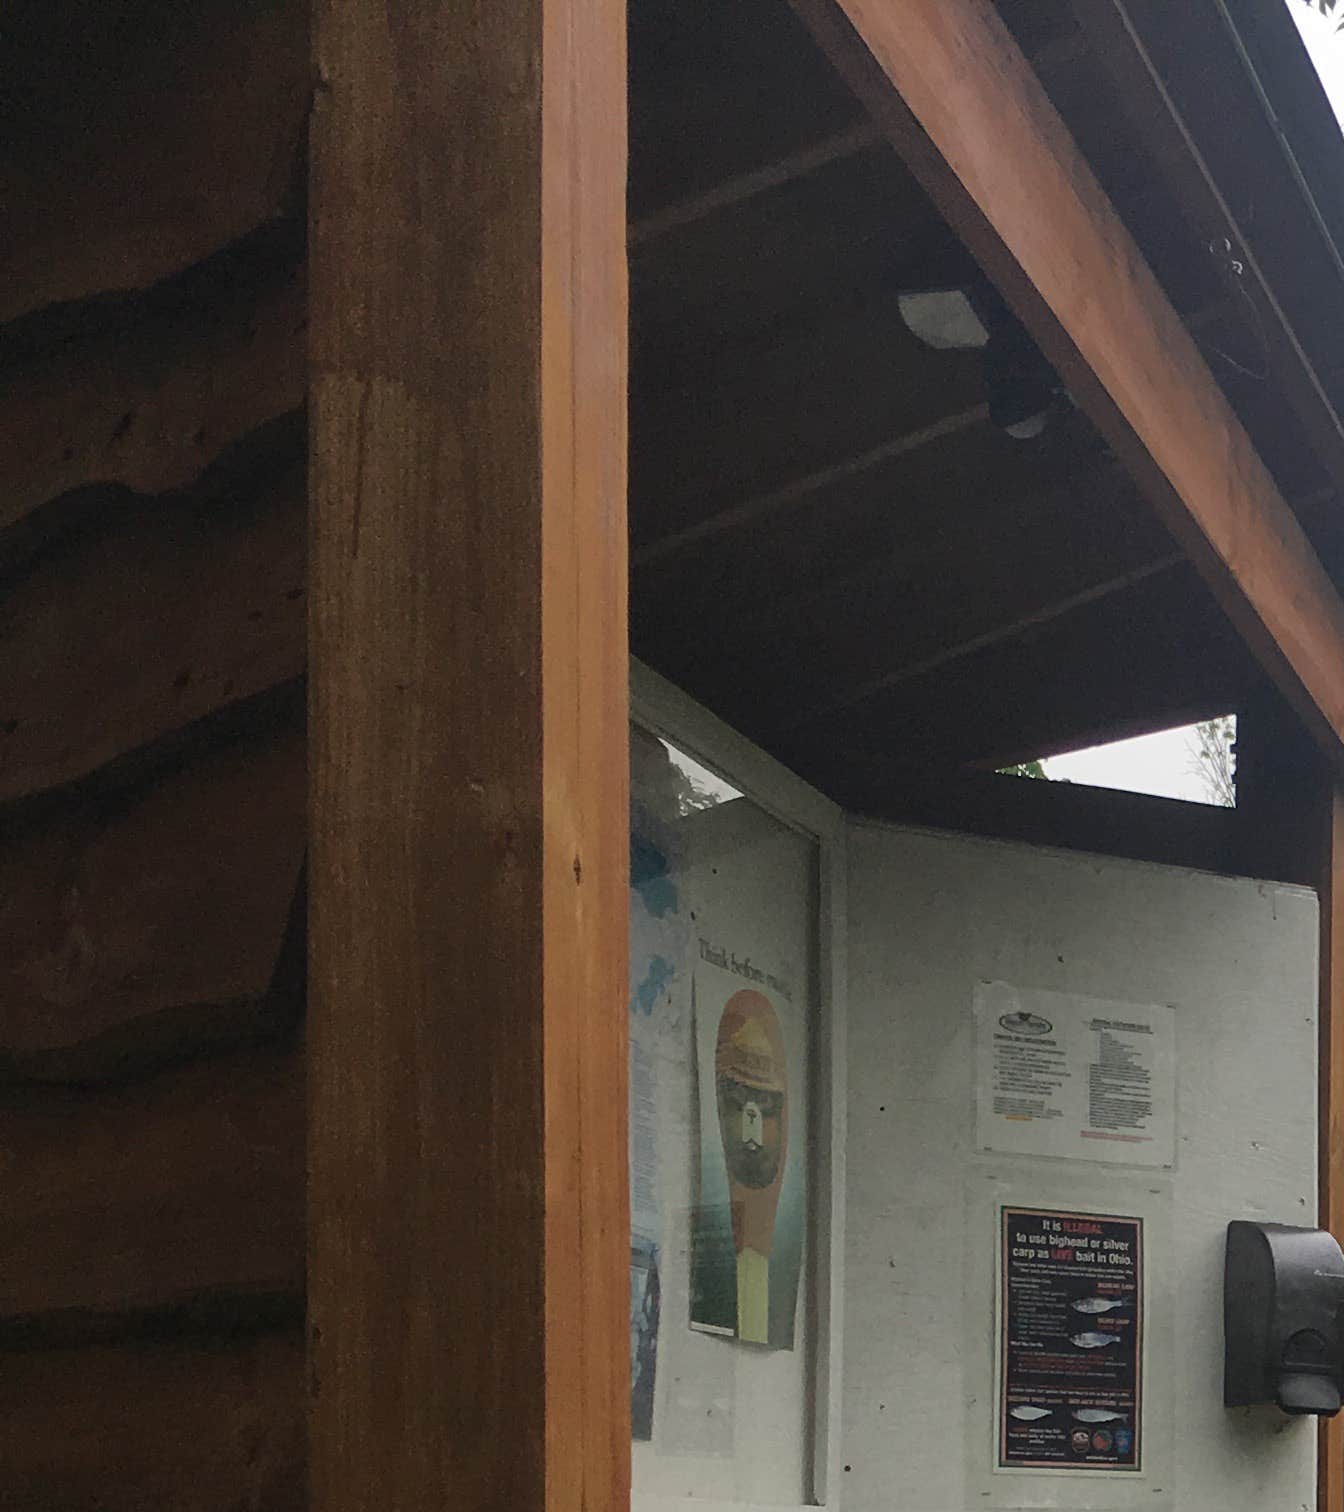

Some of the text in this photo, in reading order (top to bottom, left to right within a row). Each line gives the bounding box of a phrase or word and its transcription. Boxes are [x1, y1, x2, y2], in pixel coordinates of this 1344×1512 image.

[1053, 1221, 1062, 1232] is
[1016, 1232, 1129, 1251] to use bighead or silver
[1012, 1247, 1035, 1259] carp
[1037, 1249, 1049, 1259] as
[1075, 1251, 1095, 1263] bait
[1097, 1252, 1107, 1264] in
